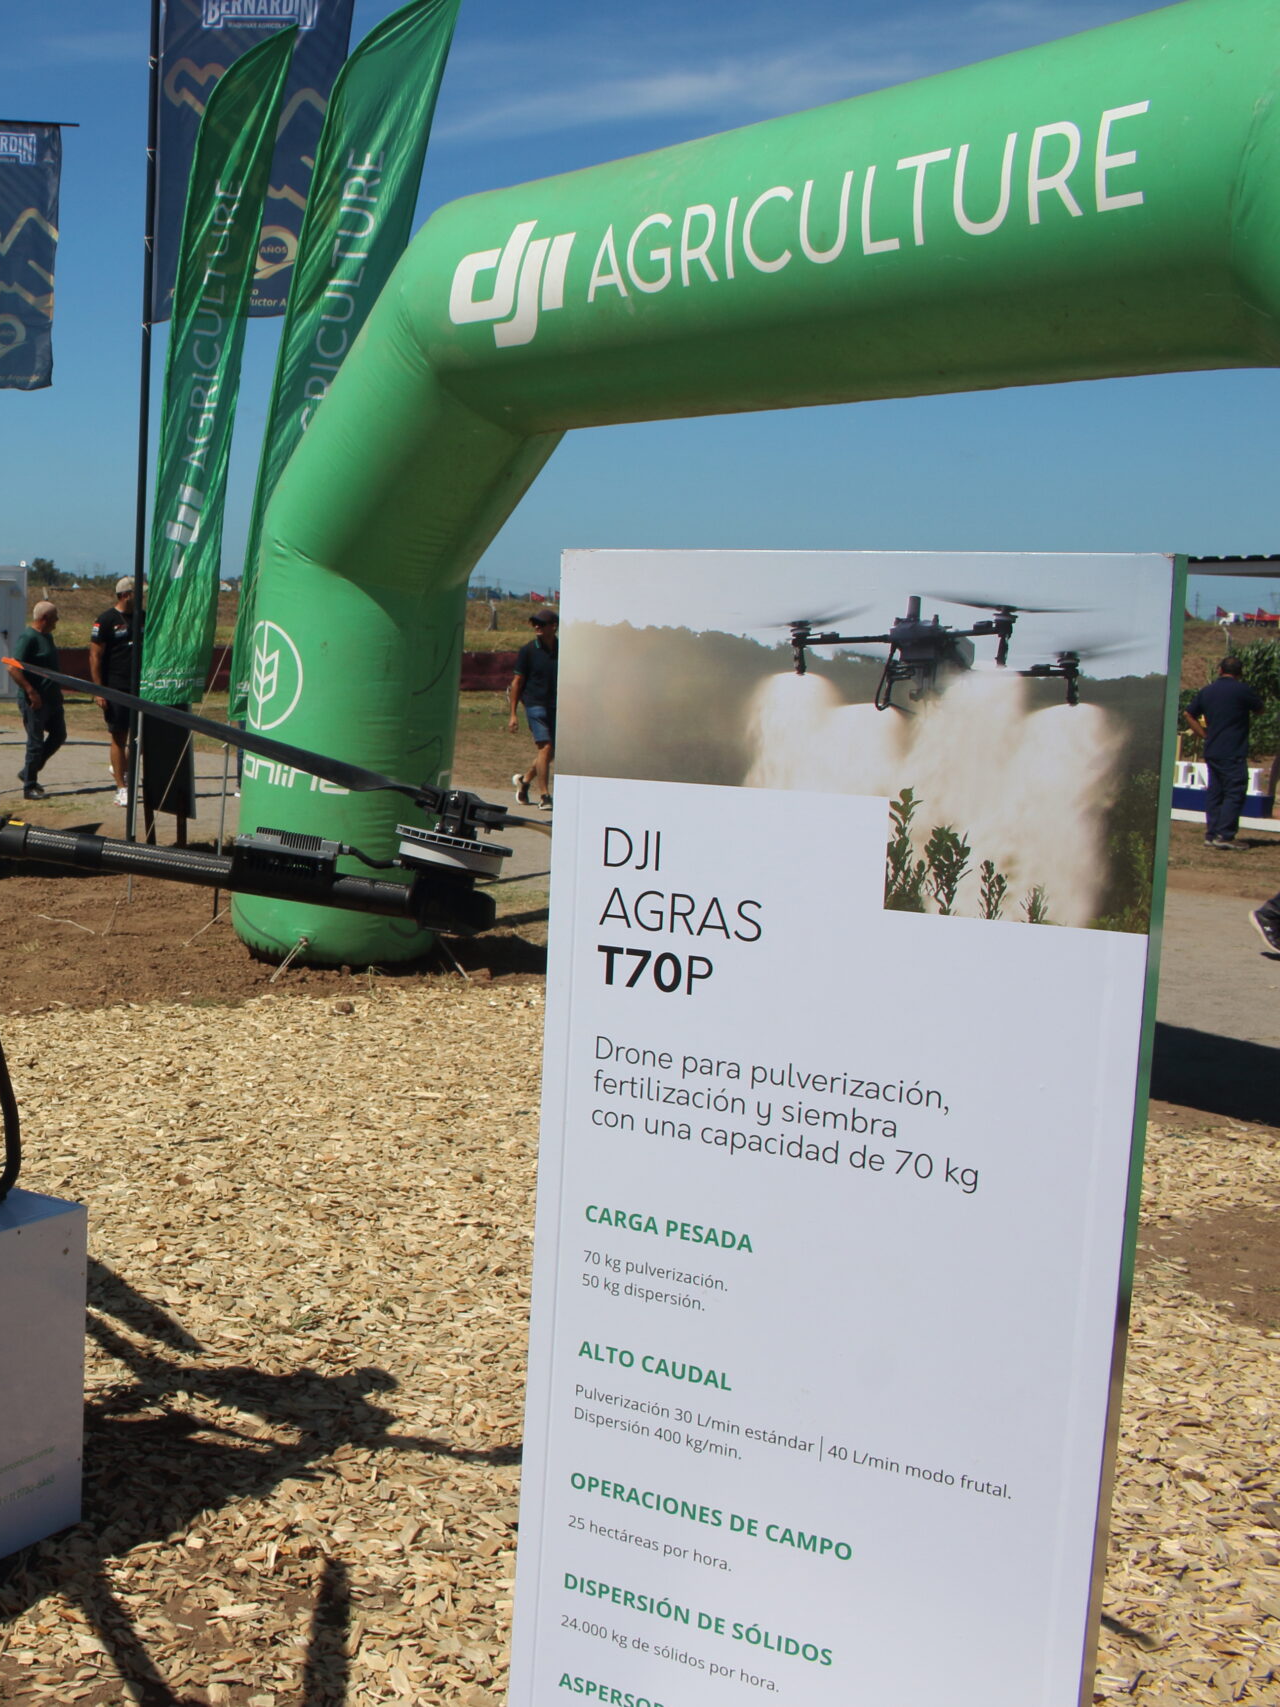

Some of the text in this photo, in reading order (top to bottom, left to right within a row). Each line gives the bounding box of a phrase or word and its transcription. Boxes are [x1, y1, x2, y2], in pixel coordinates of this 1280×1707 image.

[587, 100, 1149, 303] AGRICULTURE
[181, 178, 243, 471] AGRICULTURE
[300, 149, 384, 431] RICULTURE
[602, 826, 662, 871] DJI
[599, 887, 763, 942] AGRAS
[597, 944, 714, 996] T70P
[594, 1069, 897, 1138] fertilización y siembra
[595, 1035, 949, 1116] Drone para pulverización,
[592, 1109, 979, 1194] con una capacidad de 70 kg
[585, 1204, 753, 1253] CARGA PESADA
[582, 1273, 706, 1312] 50 kg dispersión.
[583, 1249, 728, 1292] 70 kg pulverización.
[578, 1340, 732, 1391] ALTO CAUDAL
[574, 1406, 742, 1460] Dispersión 400 kg/min.
[575, 1384, 1012, 1500] Pulverización 30 L/min estándar 40 L/min modo frutal.
[568, 1515, 732, 1572] 25 hectáreas por hora.
[570, 1472, 853, 1561] OPERACIONES DE CAMPO
[561, 1614, 780, 1693] 24.000 kg de sólidos por hora.
[564, 1573, 833, 1667] DISPERSIÓN DE SÓLIDOS
